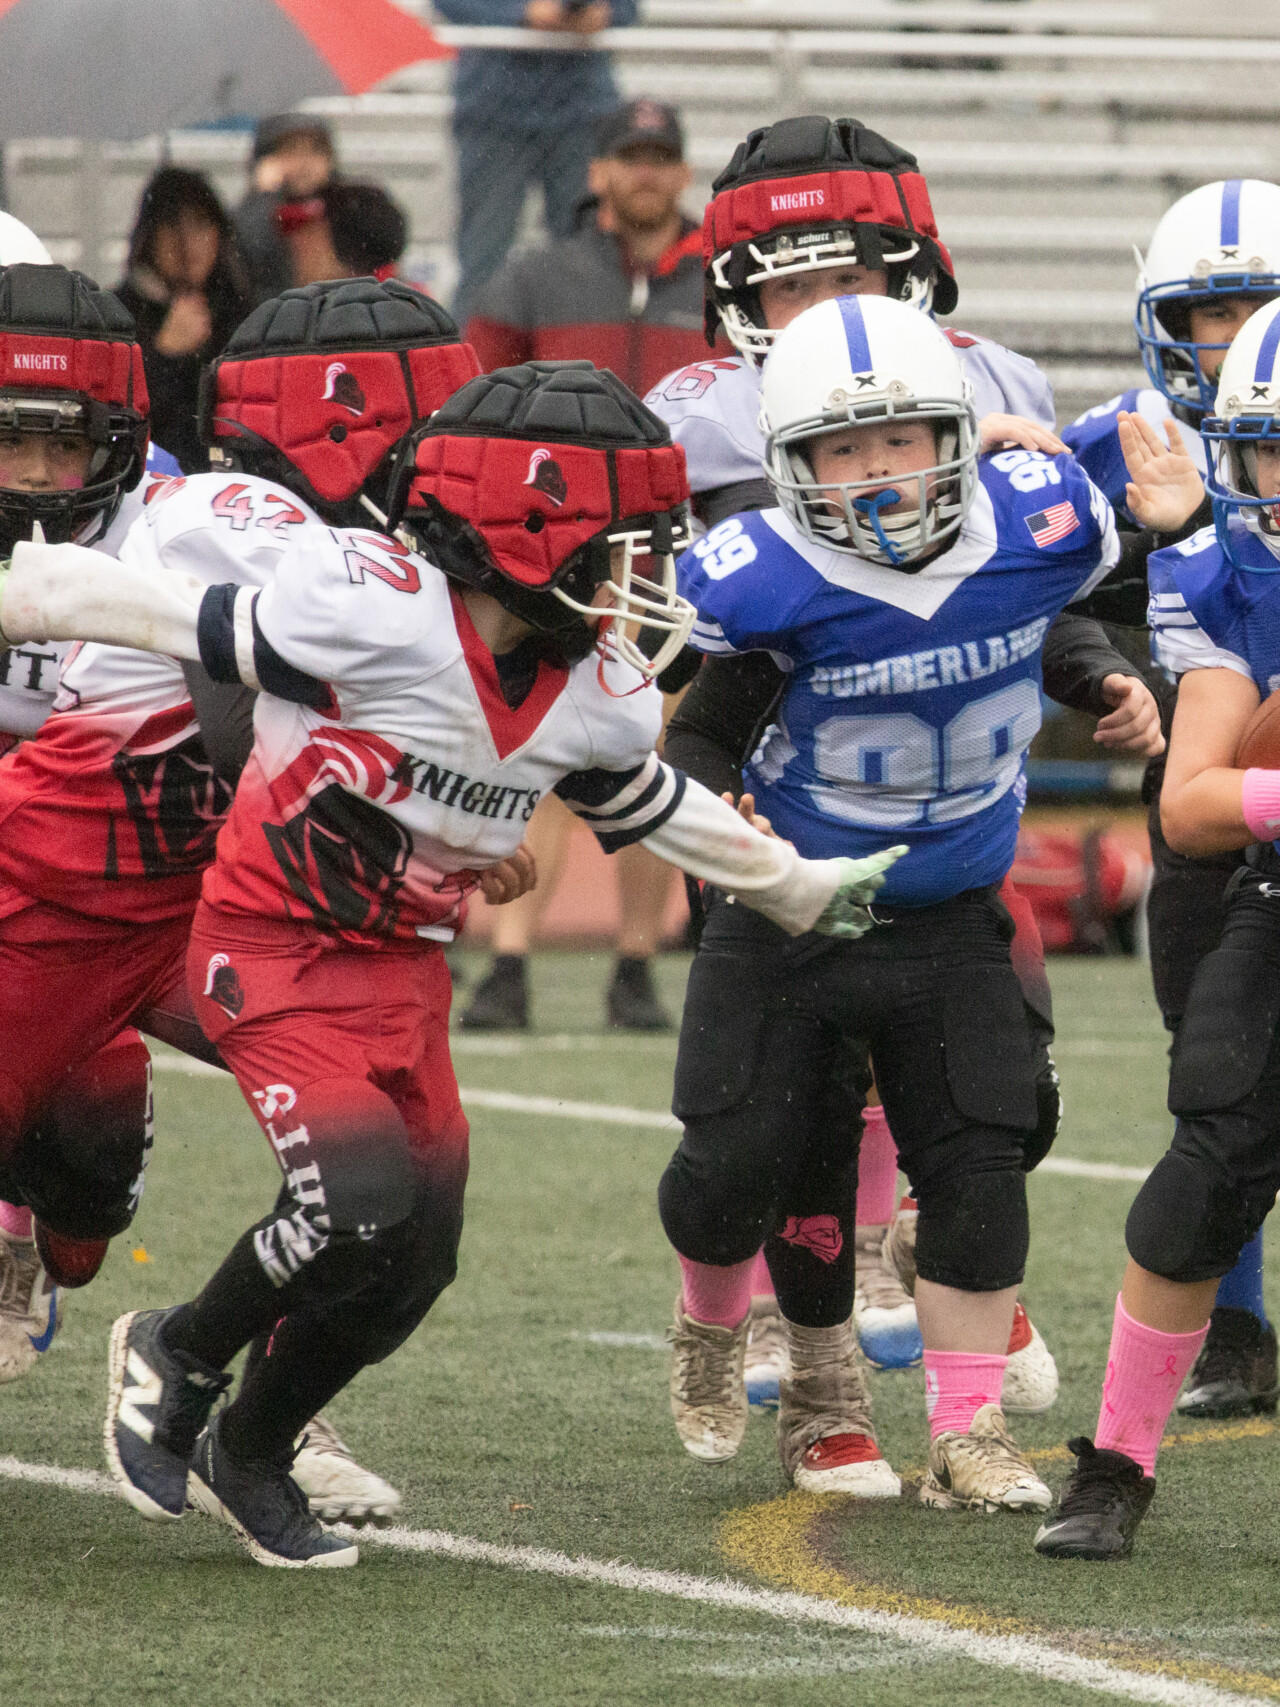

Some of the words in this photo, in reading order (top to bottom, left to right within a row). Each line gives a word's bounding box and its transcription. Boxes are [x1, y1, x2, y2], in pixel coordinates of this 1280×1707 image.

[771, 189, 825, 211] KNIGHTS
[797, 232, 830, 246] schutt
[13, 353, 68, 371] KNIGHTS
[644, 360, 742, 404] 6
[692, 518, 759, 581] 99
[386, 751, 541, 822] KNIGHTS
